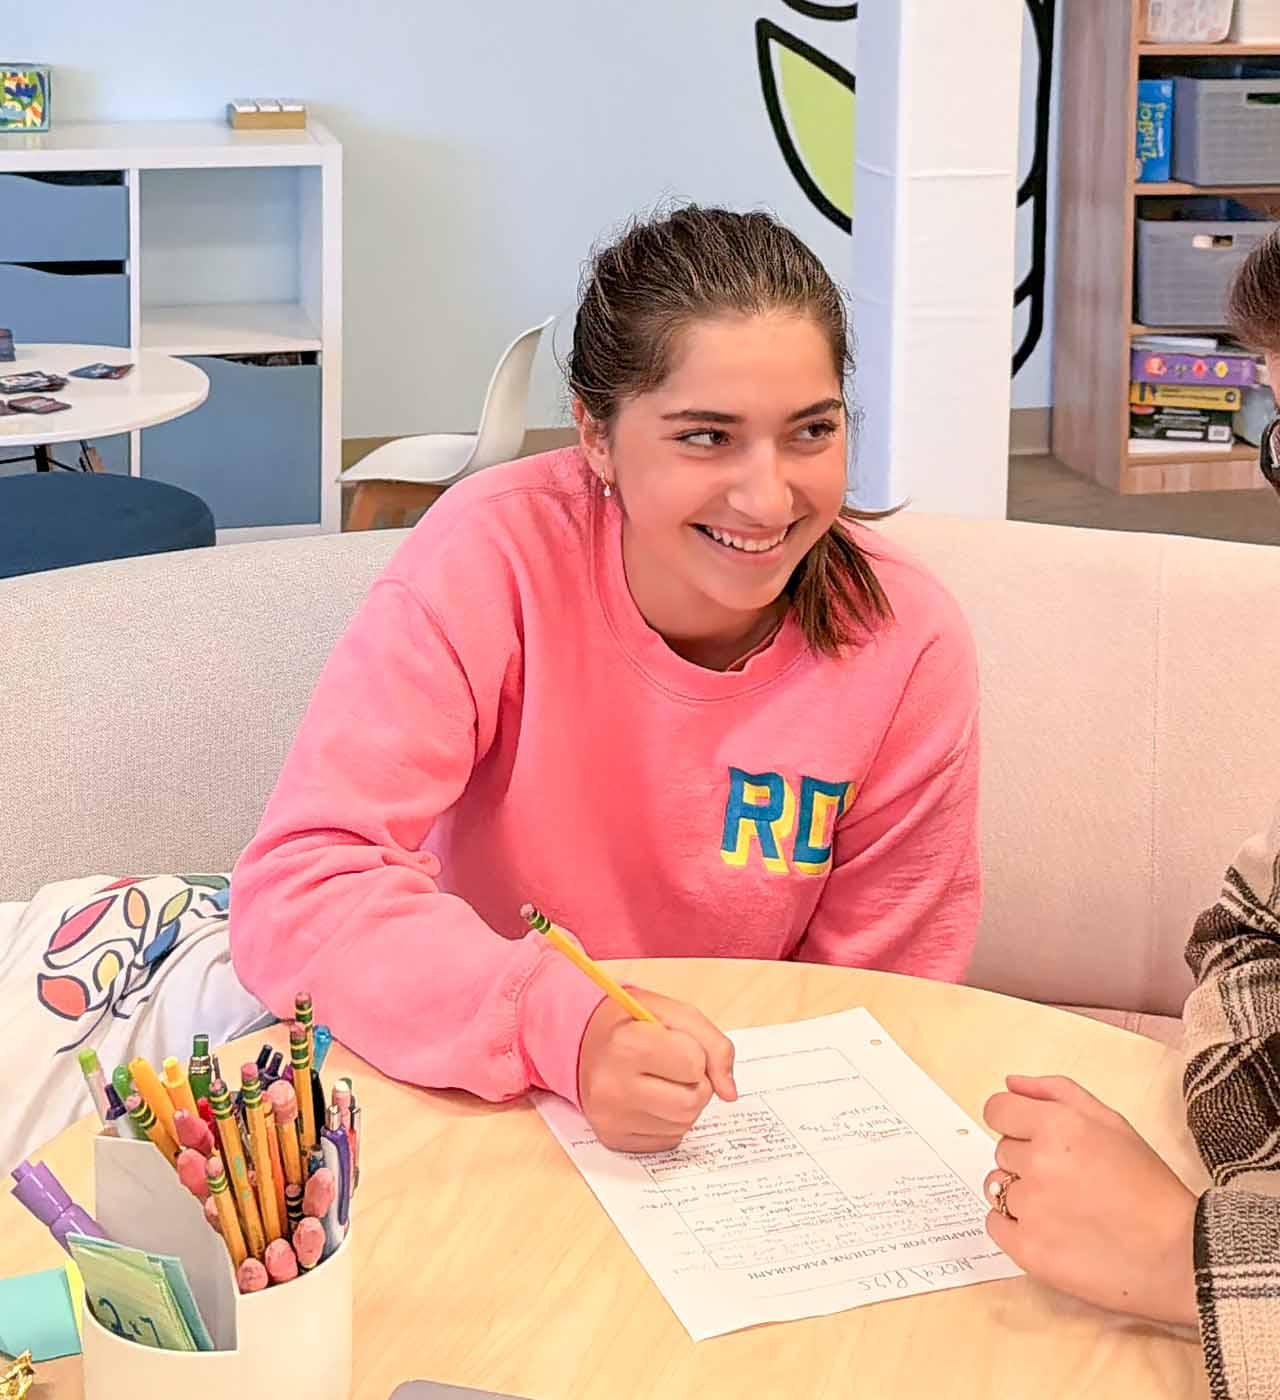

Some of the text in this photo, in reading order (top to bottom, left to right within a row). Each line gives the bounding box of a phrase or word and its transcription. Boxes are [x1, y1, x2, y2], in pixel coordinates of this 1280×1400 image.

[747, 1228, 984, 1280] SHAPING FOR A 2-CHUNK PARAGRAPH
